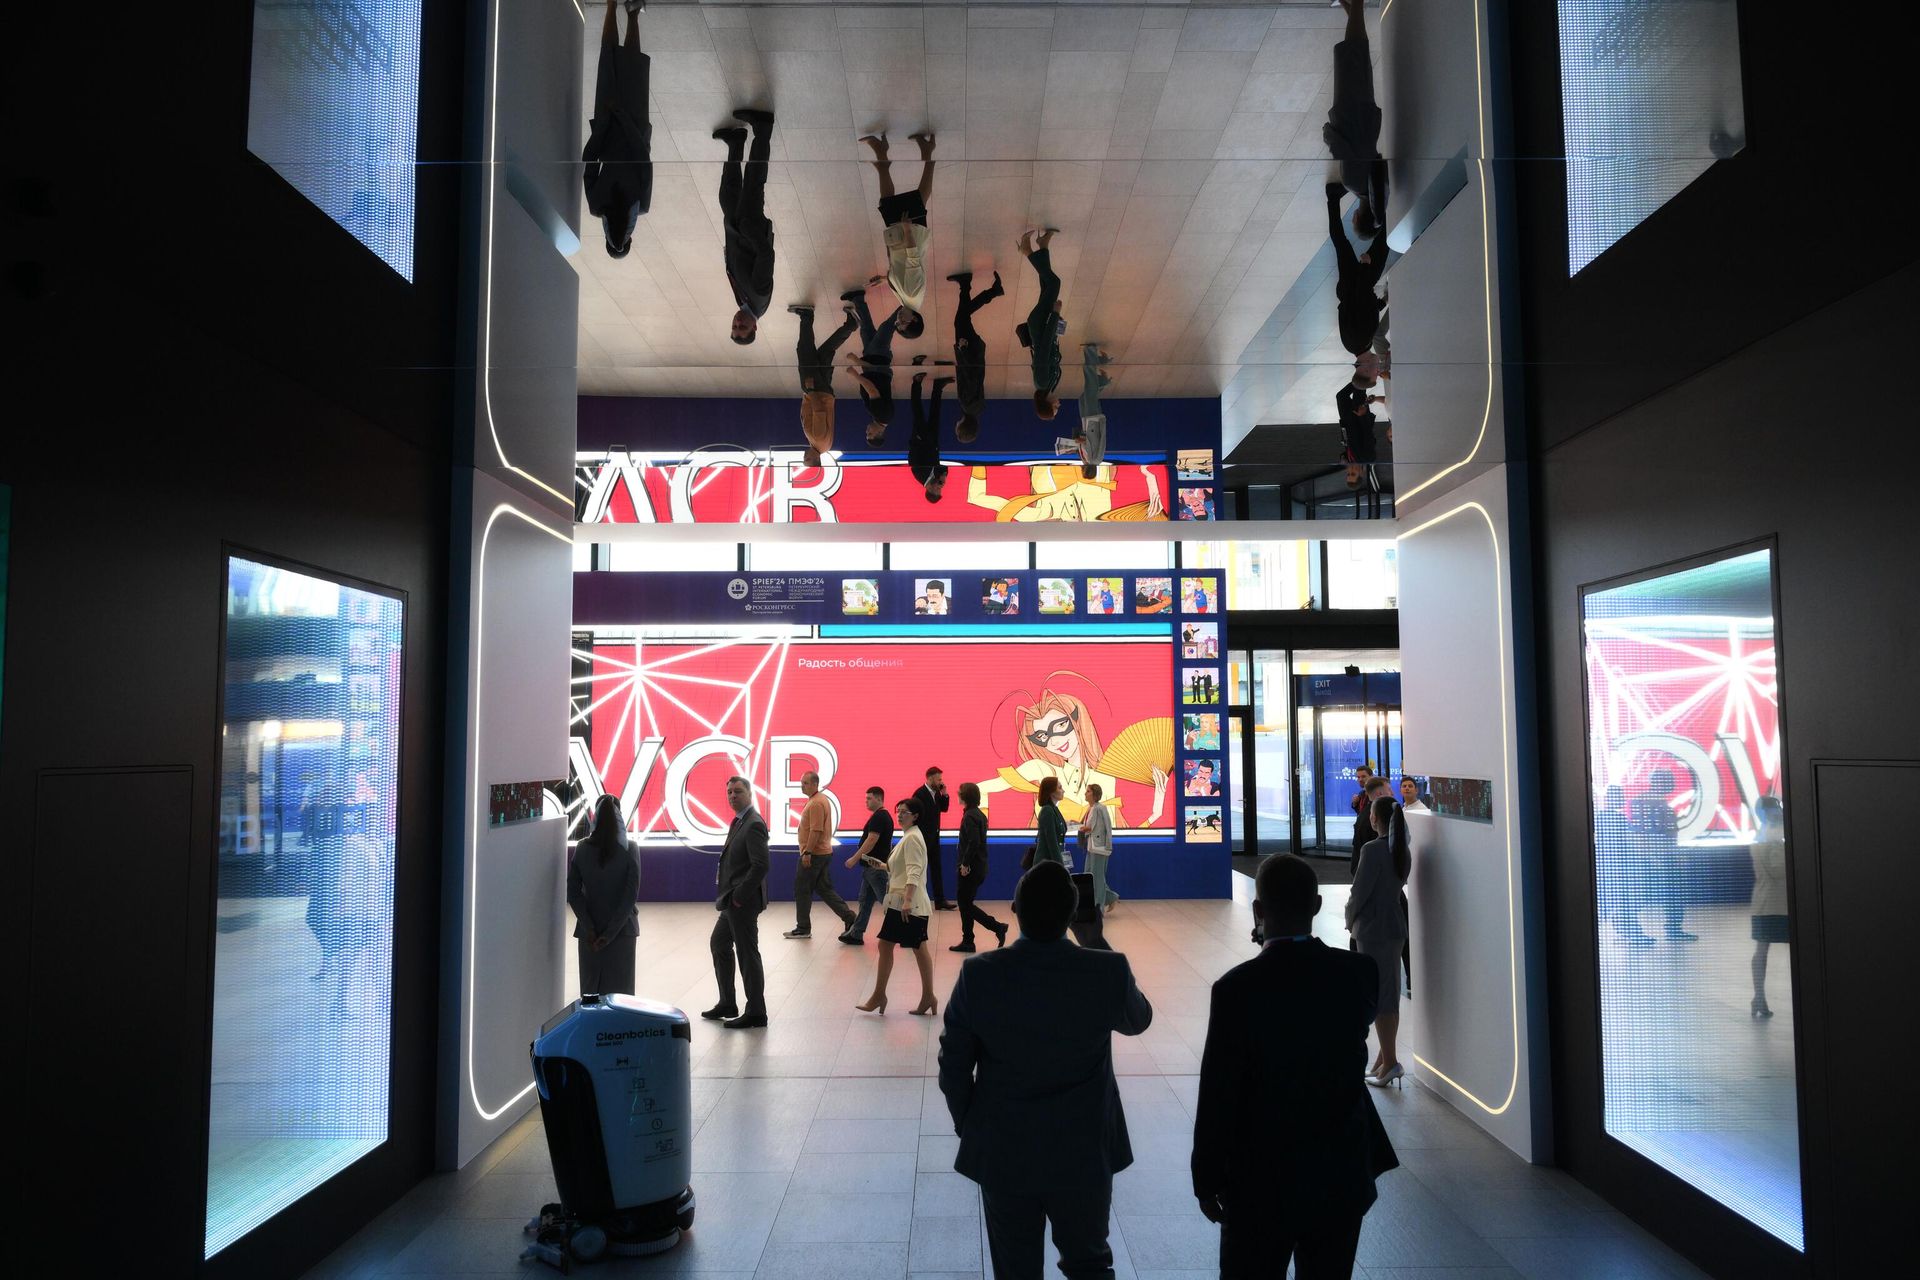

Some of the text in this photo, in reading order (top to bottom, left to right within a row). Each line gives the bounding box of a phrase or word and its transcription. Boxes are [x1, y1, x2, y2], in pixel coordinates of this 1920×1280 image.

[798, 658, 903, 669] Радость общения
[1315, 679, 1331, 688] EXIT
[596, 1028, 666, 1041] Cleanbotics
